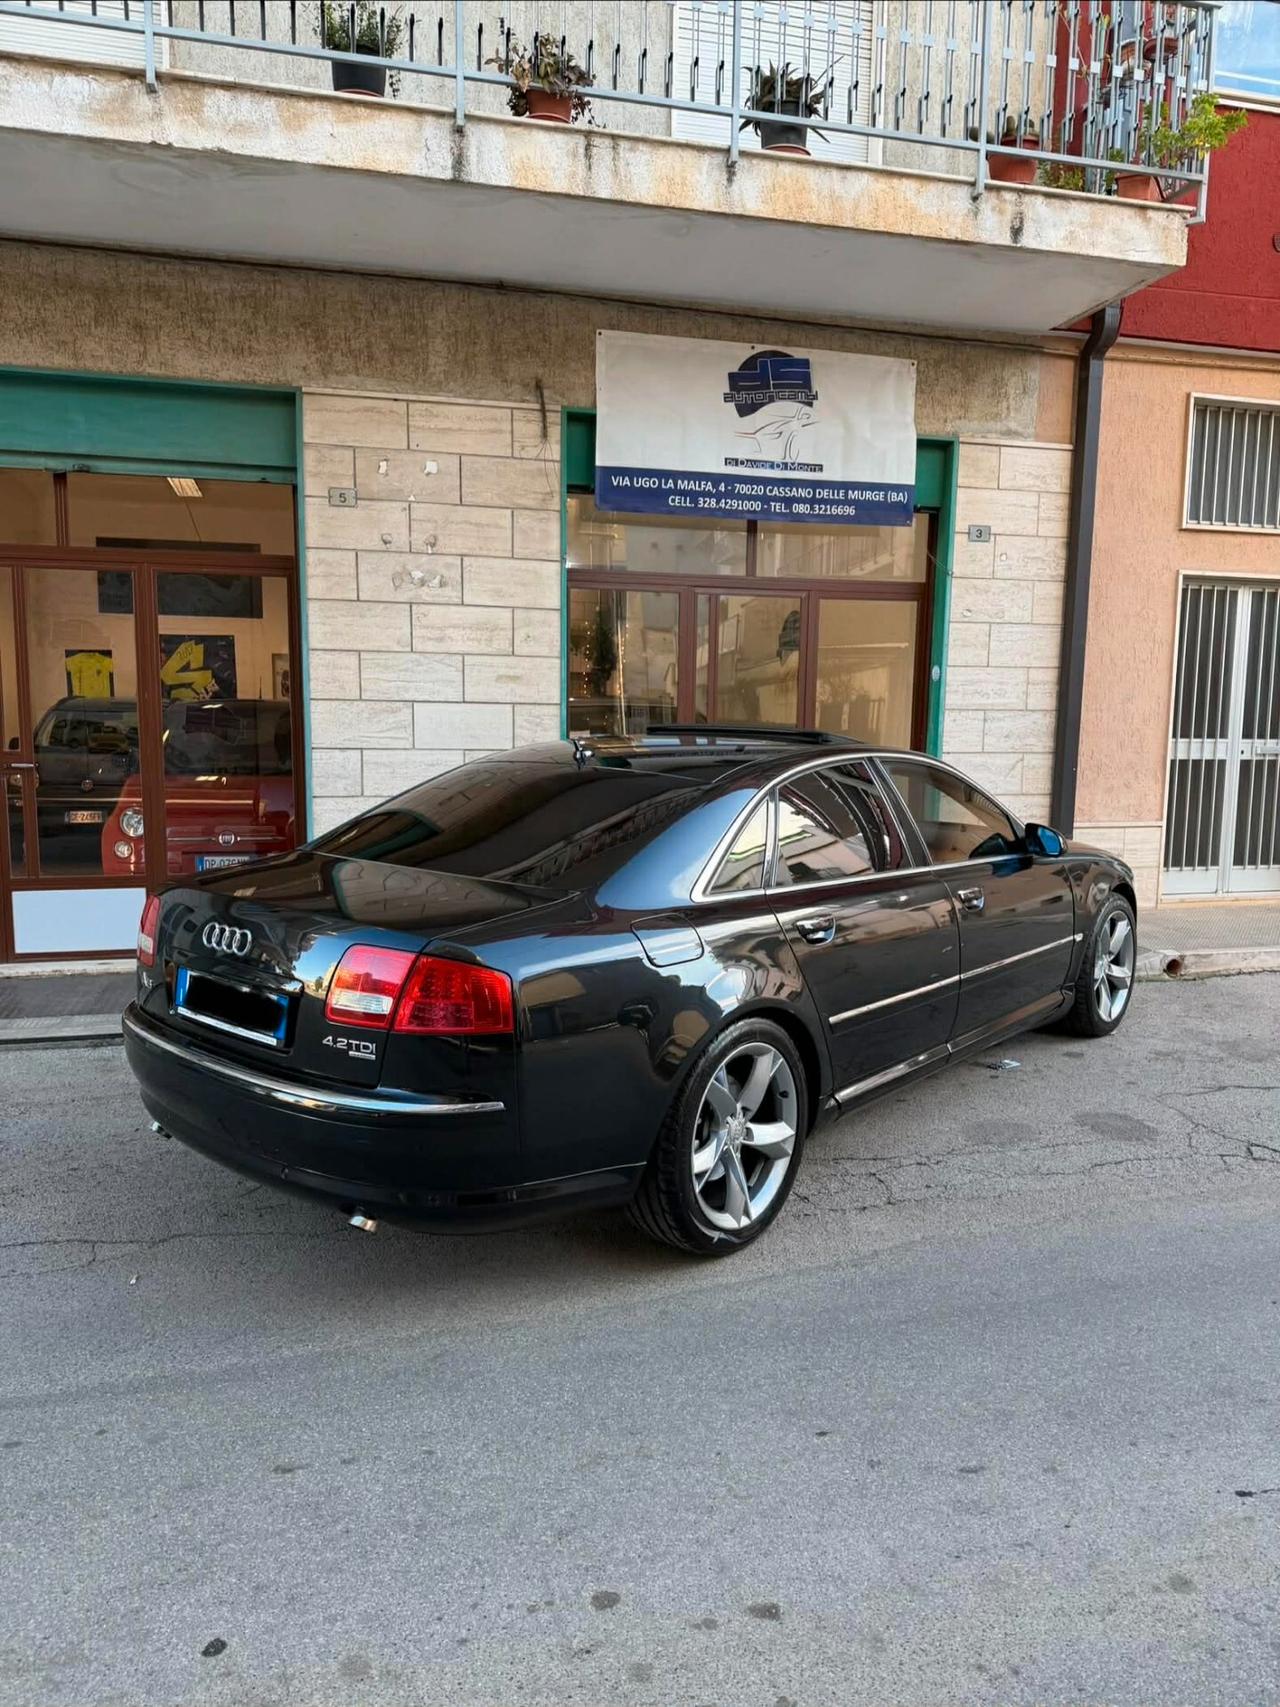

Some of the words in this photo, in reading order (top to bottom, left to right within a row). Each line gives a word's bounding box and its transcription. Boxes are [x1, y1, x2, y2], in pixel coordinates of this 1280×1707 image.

[339, 492, 347, 503] 5
[611, 475, 631, 487] VIA
[633, 477, 659, 489] UGO
[661, 478, 675, 490] LA
[677, 479, 717, 494] MALFA,
[718, 482, 726, 493] 4
[734, 483, 764, 496] 70020
[766, 485, 814, 499] CASSANO
[816, 488, 846, 500] DELLE
[848, 489, 885, 502] MURGE
[887, 490, 908, 504] (BA)
[668, 495, 695, 507] CELL.
[697, 497, 762, 511] 328.4291000
[770, 502, 790, 513] TEL.
[792, 503, 856, 516] 080.3216696
[976, 528, 983, 539] 3
